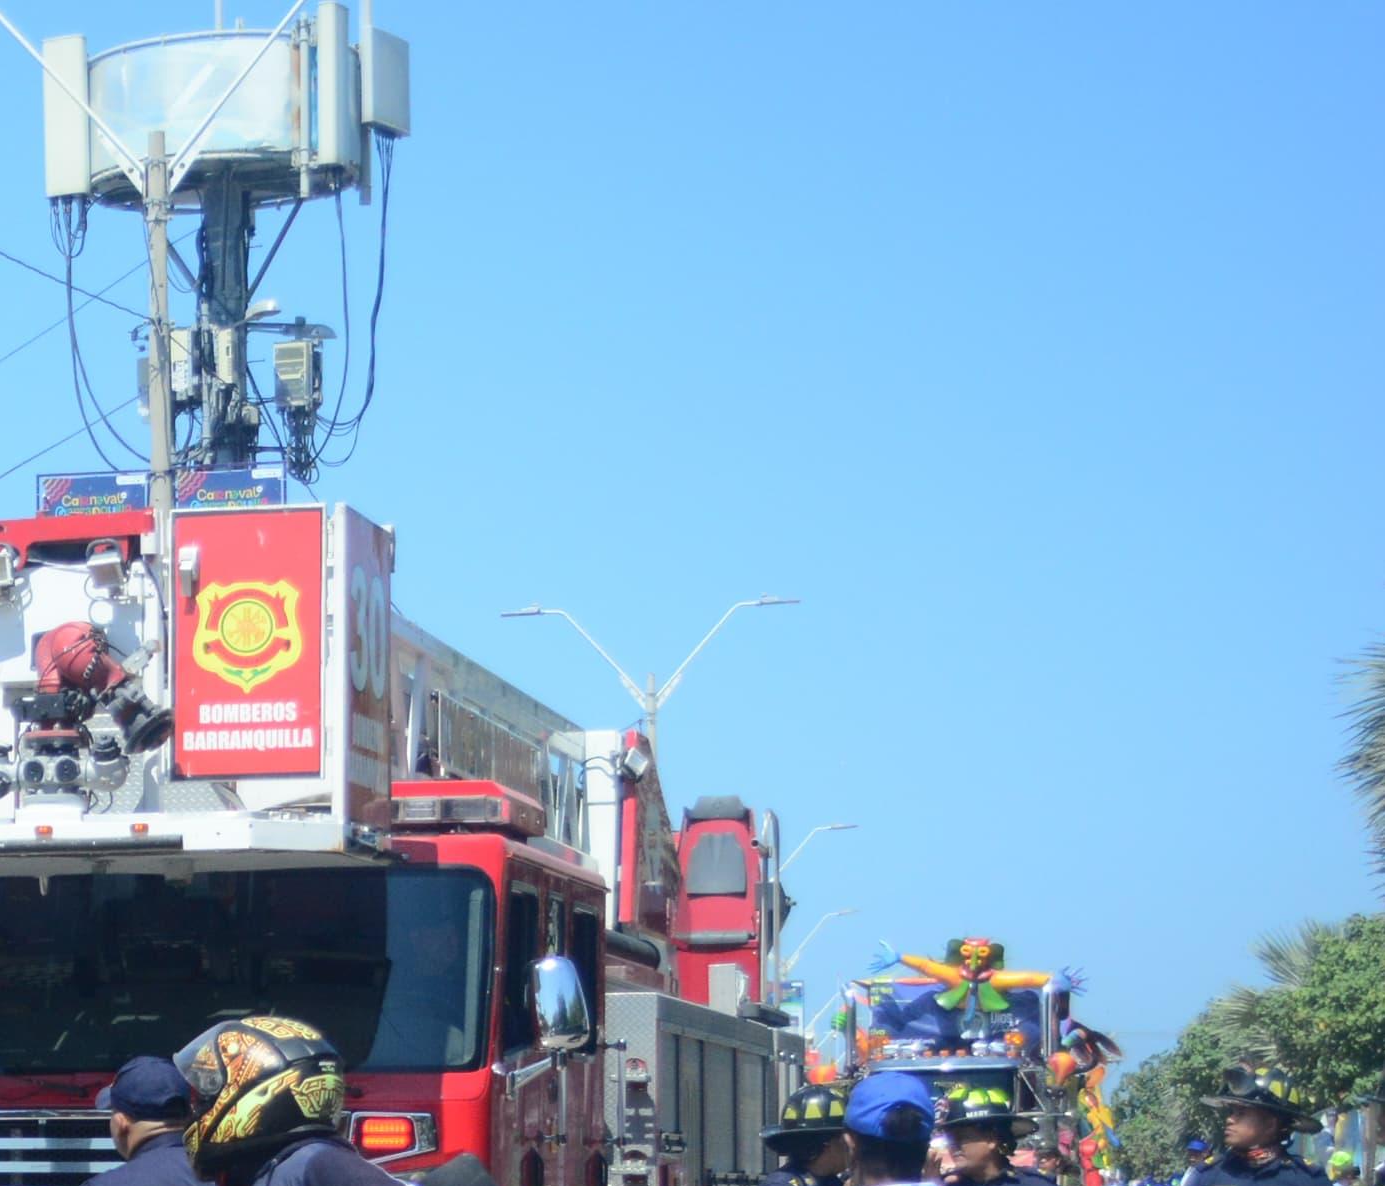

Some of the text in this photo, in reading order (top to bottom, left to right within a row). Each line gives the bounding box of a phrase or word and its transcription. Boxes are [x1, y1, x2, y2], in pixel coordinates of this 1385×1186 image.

[350, 564, 387, 700] 30
[199, 701, 298, 725] BOMBEROS
[183, 727, 314, 752] BARRANQUILLA
